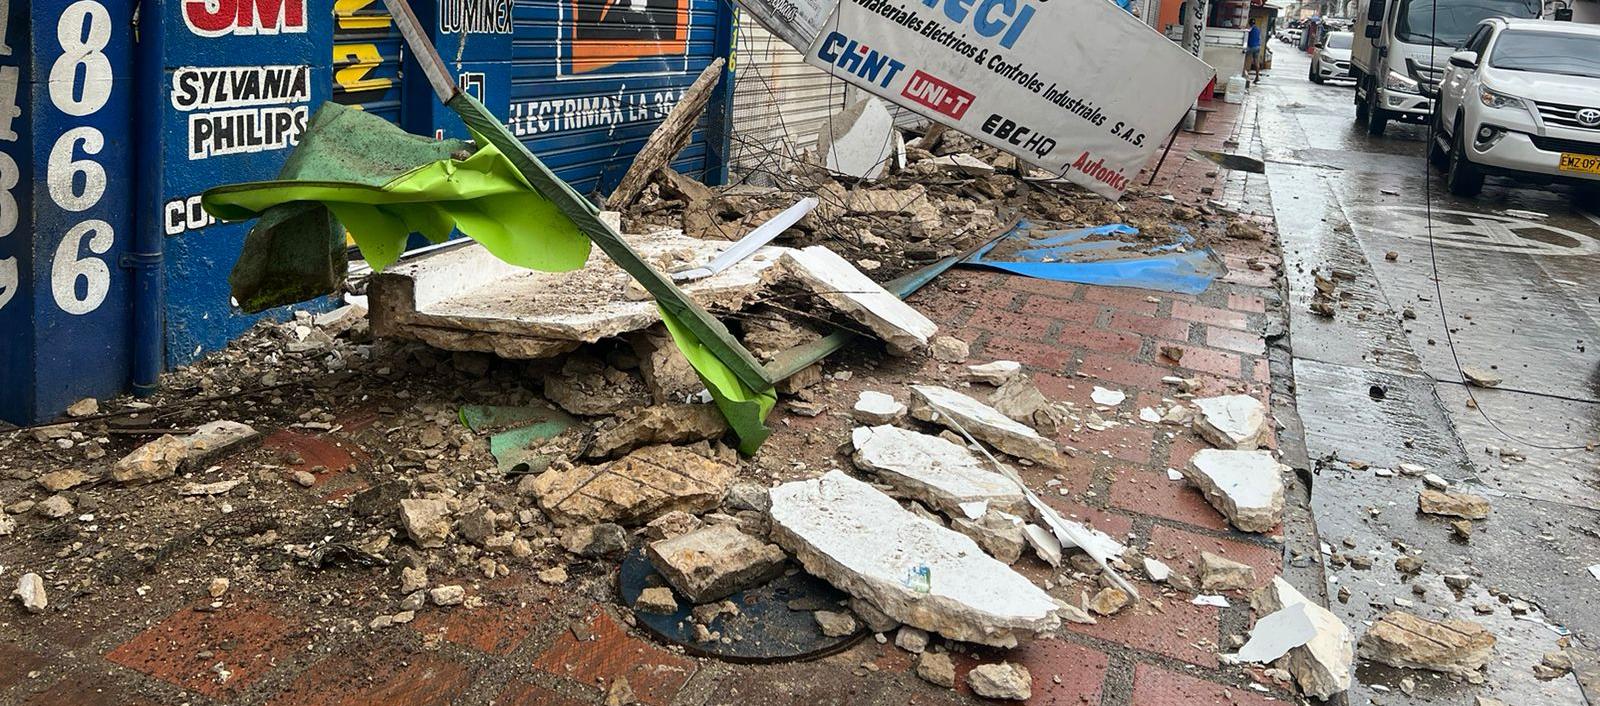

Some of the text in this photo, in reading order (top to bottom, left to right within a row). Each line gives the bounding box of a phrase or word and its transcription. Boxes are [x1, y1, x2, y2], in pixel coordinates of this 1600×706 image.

[181, 0, 308, 38] 3M
[439, 0, 514, 34] LUMINEX
[171, 66, 311, 110] SYLVANIA
[920, 20, 978, 58] Eléctricos
[975, 48, 989, 66] &
[987, 54, 1044, 94] Controles
[1042, 83, 1109, 127] Industriales
[1110, 121, 1144, 148] S.A.S.
[629, 93, 648, 122] LA
[188, 106, 309, 160] PHILIPS
[906, 75, 972, 117] UNI-T
[1072, 151, 1131, 192] Autonics
